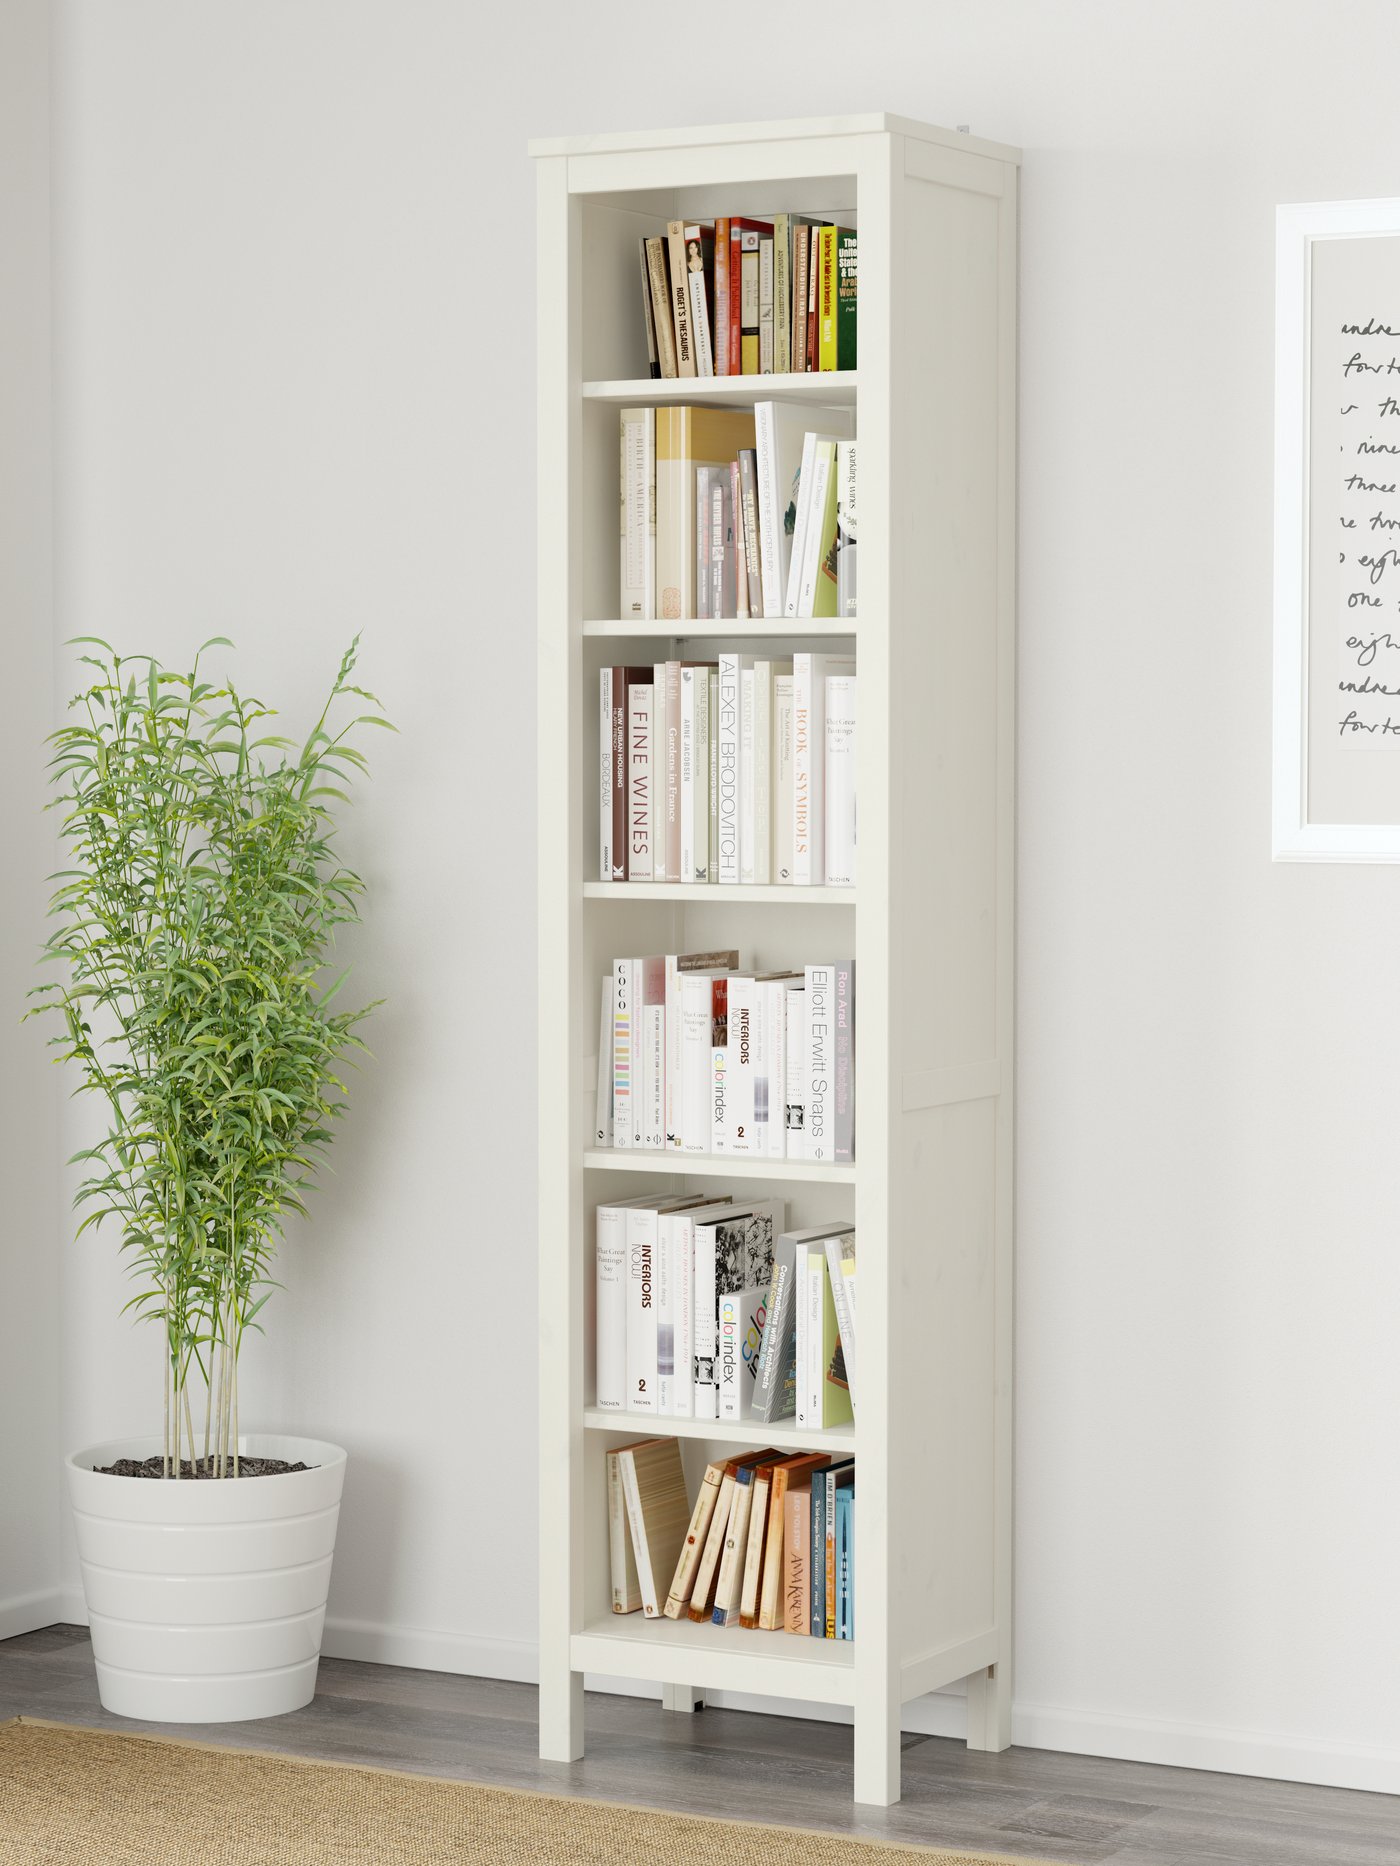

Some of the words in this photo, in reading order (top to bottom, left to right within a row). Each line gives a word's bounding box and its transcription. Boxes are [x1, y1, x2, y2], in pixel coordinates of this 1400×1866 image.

[844, 238, 857, 248] The
[841, 268, 847, 277] &
[676, 287, 686, 317] ROGET'S
[679, 320, 690, 362] THESAURUS
[636, 438, 644, 470] BIRTH
[848, 448, 857, 482] sparkling
[815, 486, 823, 509] Design
[1344, 474, 1396, 492] three
[636, 482, 644, 527] AMERICA
[748, 506, 756, 530] BRAVE
[761, 441, 770, 490] ARCHITECTURE
[766, 538, 774, 572] CENTURY
[1348, 592, 1383, 608] one
[721, 660, 735, 735] ALEXEY
[744, 680, 752, 732] MAKING
[633, 712, 648, 764] FINE
[669, 727, 677, 771] Gardens
[796, 709, 807, 754] BOOK
[602, 753, 610, 807] BORDEAUX
[669, 774, 677, 783] in
[633, 776, 648, 854] WINES
[669, 786, 677, 822] France
[721, 742, 735, 868] BRODOVITCH
[796, 773, 807, 853] SYMBOLS
[812, 970, 827, 1017] Elliott
[838, 972, 847, 996] Ron
[731, 1008, 740, 1039] NOW!
[838, 1000, 847, 1028] Arad
[740, 1008, 750, 1064] INTERIORS
[812, 1024, 827, 1072] Erwitt
[714, 1053, 727, 1123] colorindex
[810, 1079, 827, 1137] Snaps
[738, 1127, 744, 1138] 2
[631, 1243, 641, 1279] NOW!
[642, 1244, 651, 1308] INTERIORS
[772, 1265, 787, 1325] Conversations
[834, 1283, 846, 1302] ON
[723, 1303, 736, 1384] colorindex
[768, 1328, 779, 1345] with
[837, 1310, 852, 1338] LINE
[638, 1379, 646, 1392] 2
[762, 1346, 775, 1390] Architects
[791, 1553, 803, 1584] ANNA
